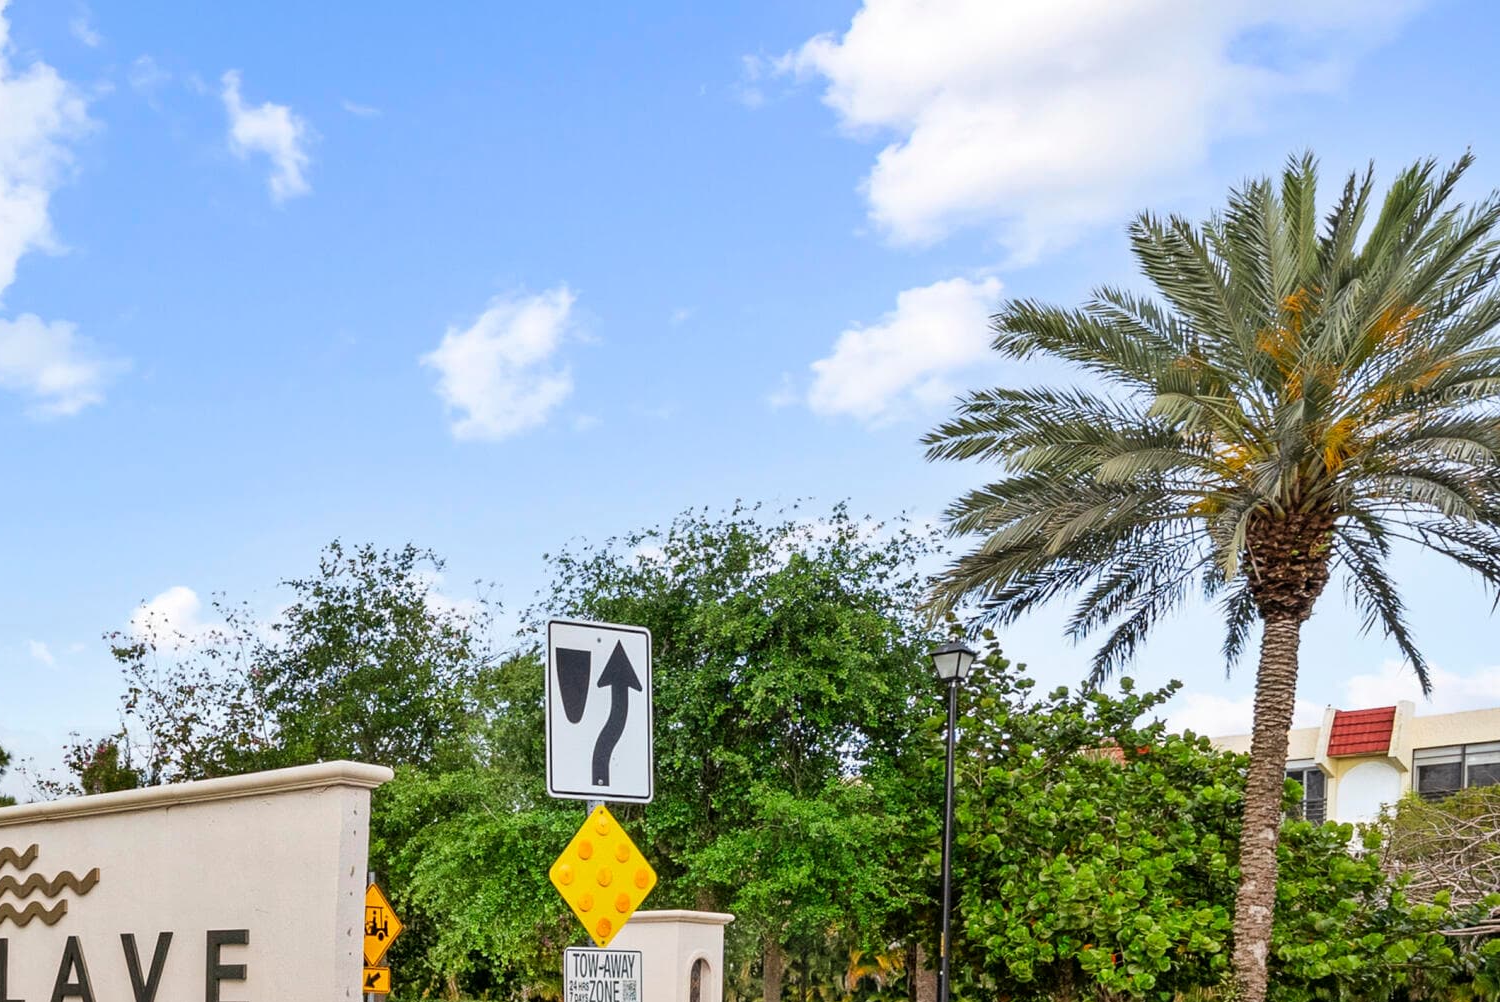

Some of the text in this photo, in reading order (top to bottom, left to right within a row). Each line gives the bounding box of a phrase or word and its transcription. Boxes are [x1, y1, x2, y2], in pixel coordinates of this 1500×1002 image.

[573, 953, 635, 979] TOW-AWAY
[569, 980, 589, 991] 24 HRS
[569, 992, 589, 1002] 7 DAYS
